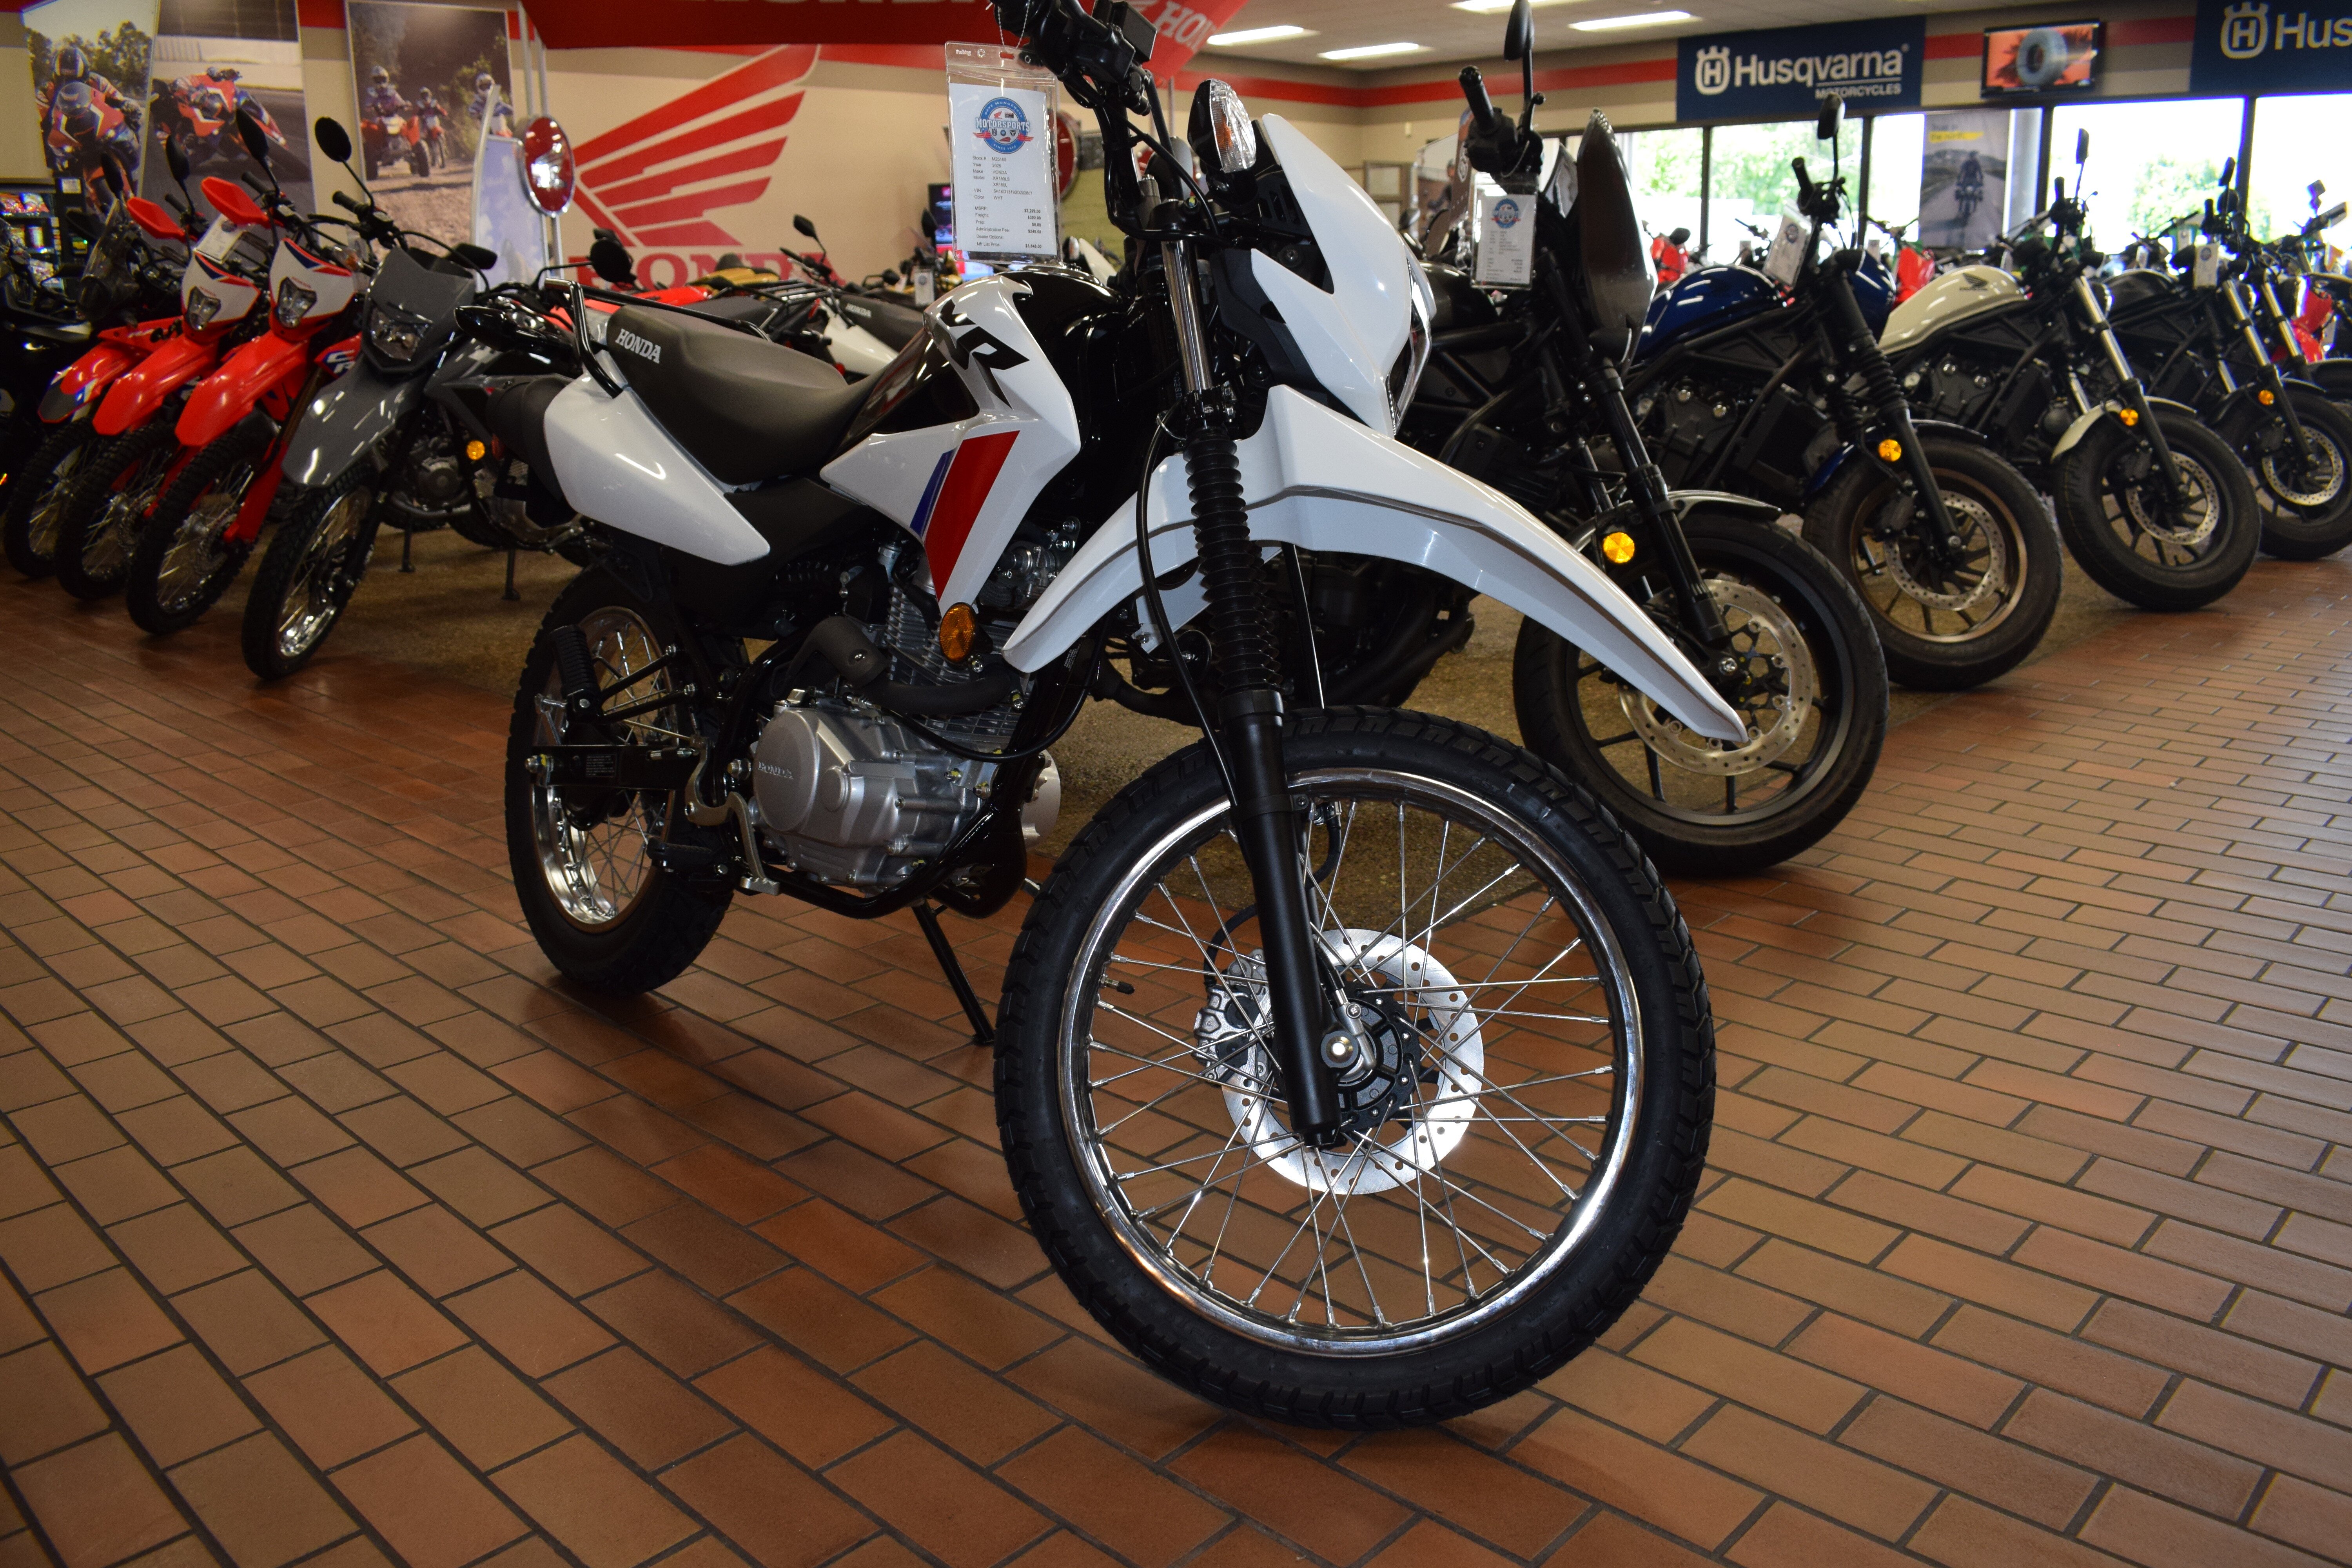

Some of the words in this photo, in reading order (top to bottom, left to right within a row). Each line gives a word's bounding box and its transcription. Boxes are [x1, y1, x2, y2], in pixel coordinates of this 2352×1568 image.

[2274, 12, 2352, 50] Hus
[1734, 49, 1902, 87] Husqvarna
[1815, 82, 1902, 100] MOTORCYCLES
[976, 118, 1030, 132] MOTORSPORTS
[846, 303, 872, 318] HONDA
[615, 328, 662, 364] HONDA
[757, 761, 795, 780] HONDA
